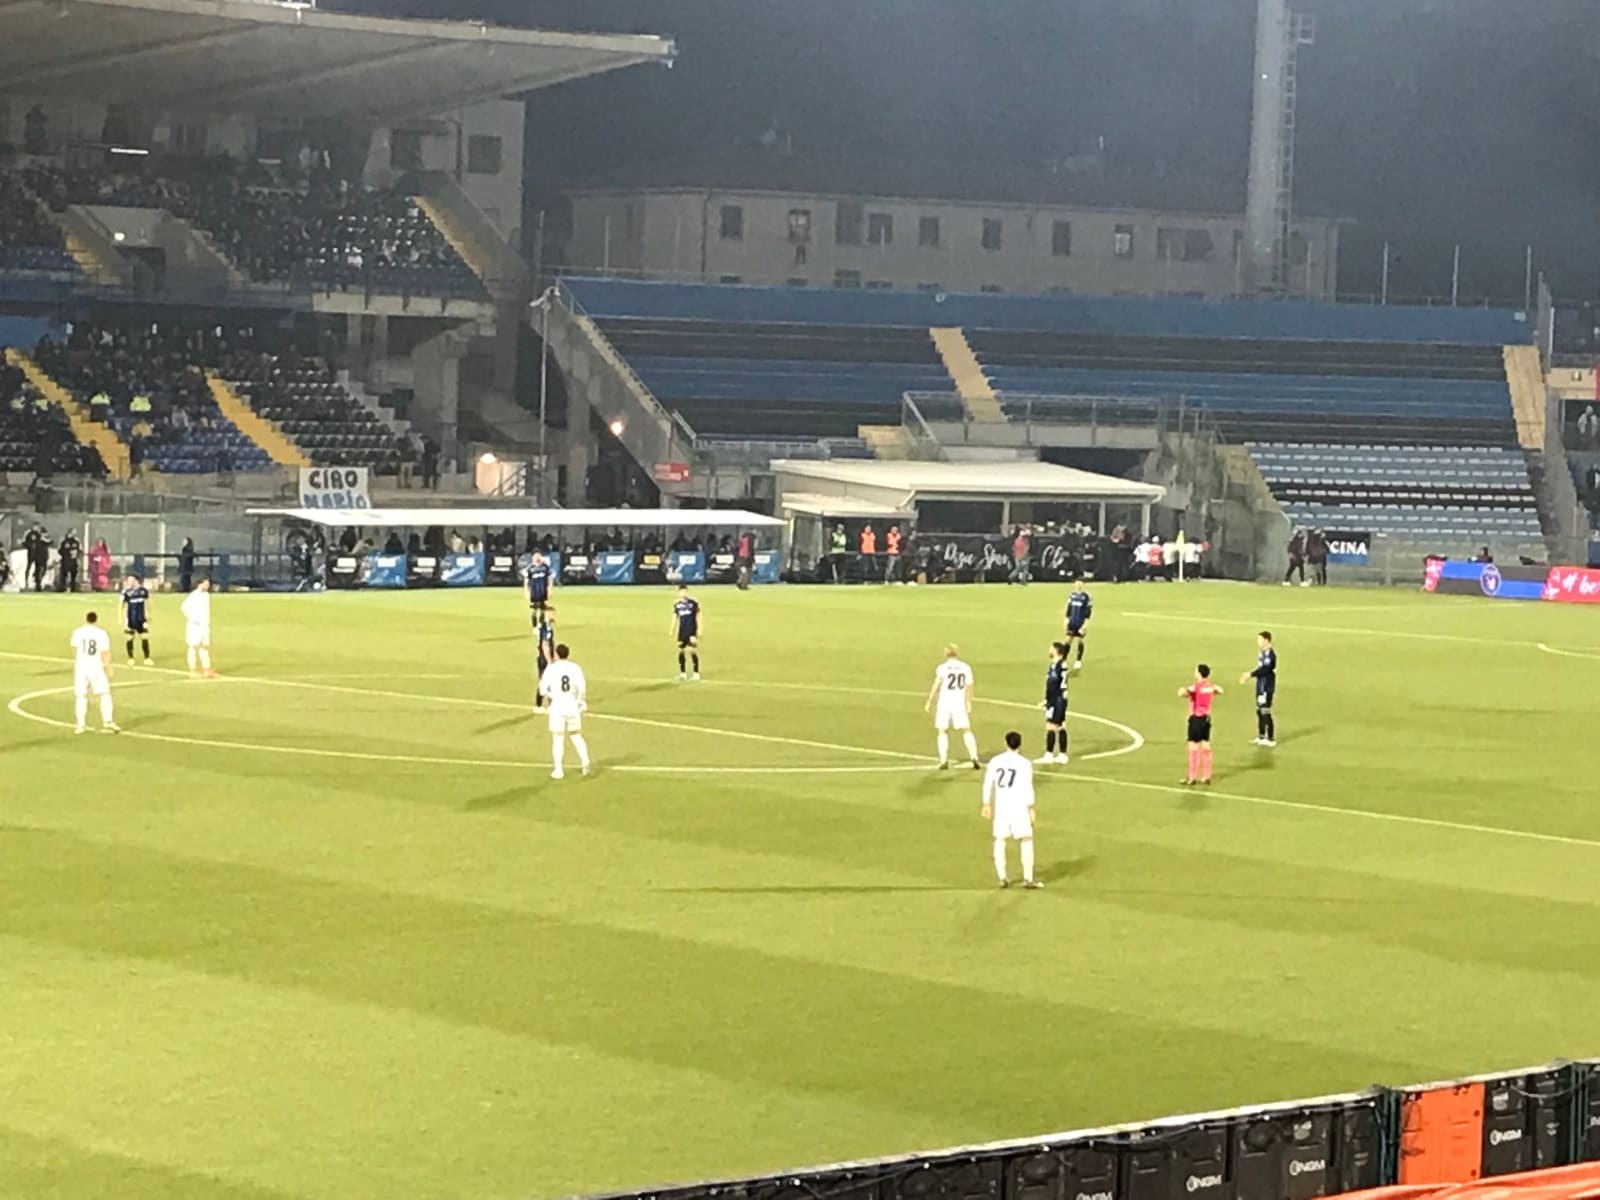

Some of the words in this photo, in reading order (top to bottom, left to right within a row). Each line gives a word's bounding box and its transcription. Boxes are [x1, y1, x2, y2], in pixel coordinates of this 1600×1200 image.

[309, 469, 358, 489] CIAO
[81, 639, 97, 656] 18
[560, 674, 571, 692] 8
[947, 672, 966, 690] 20
[996, 767, 1018, 788] 27
